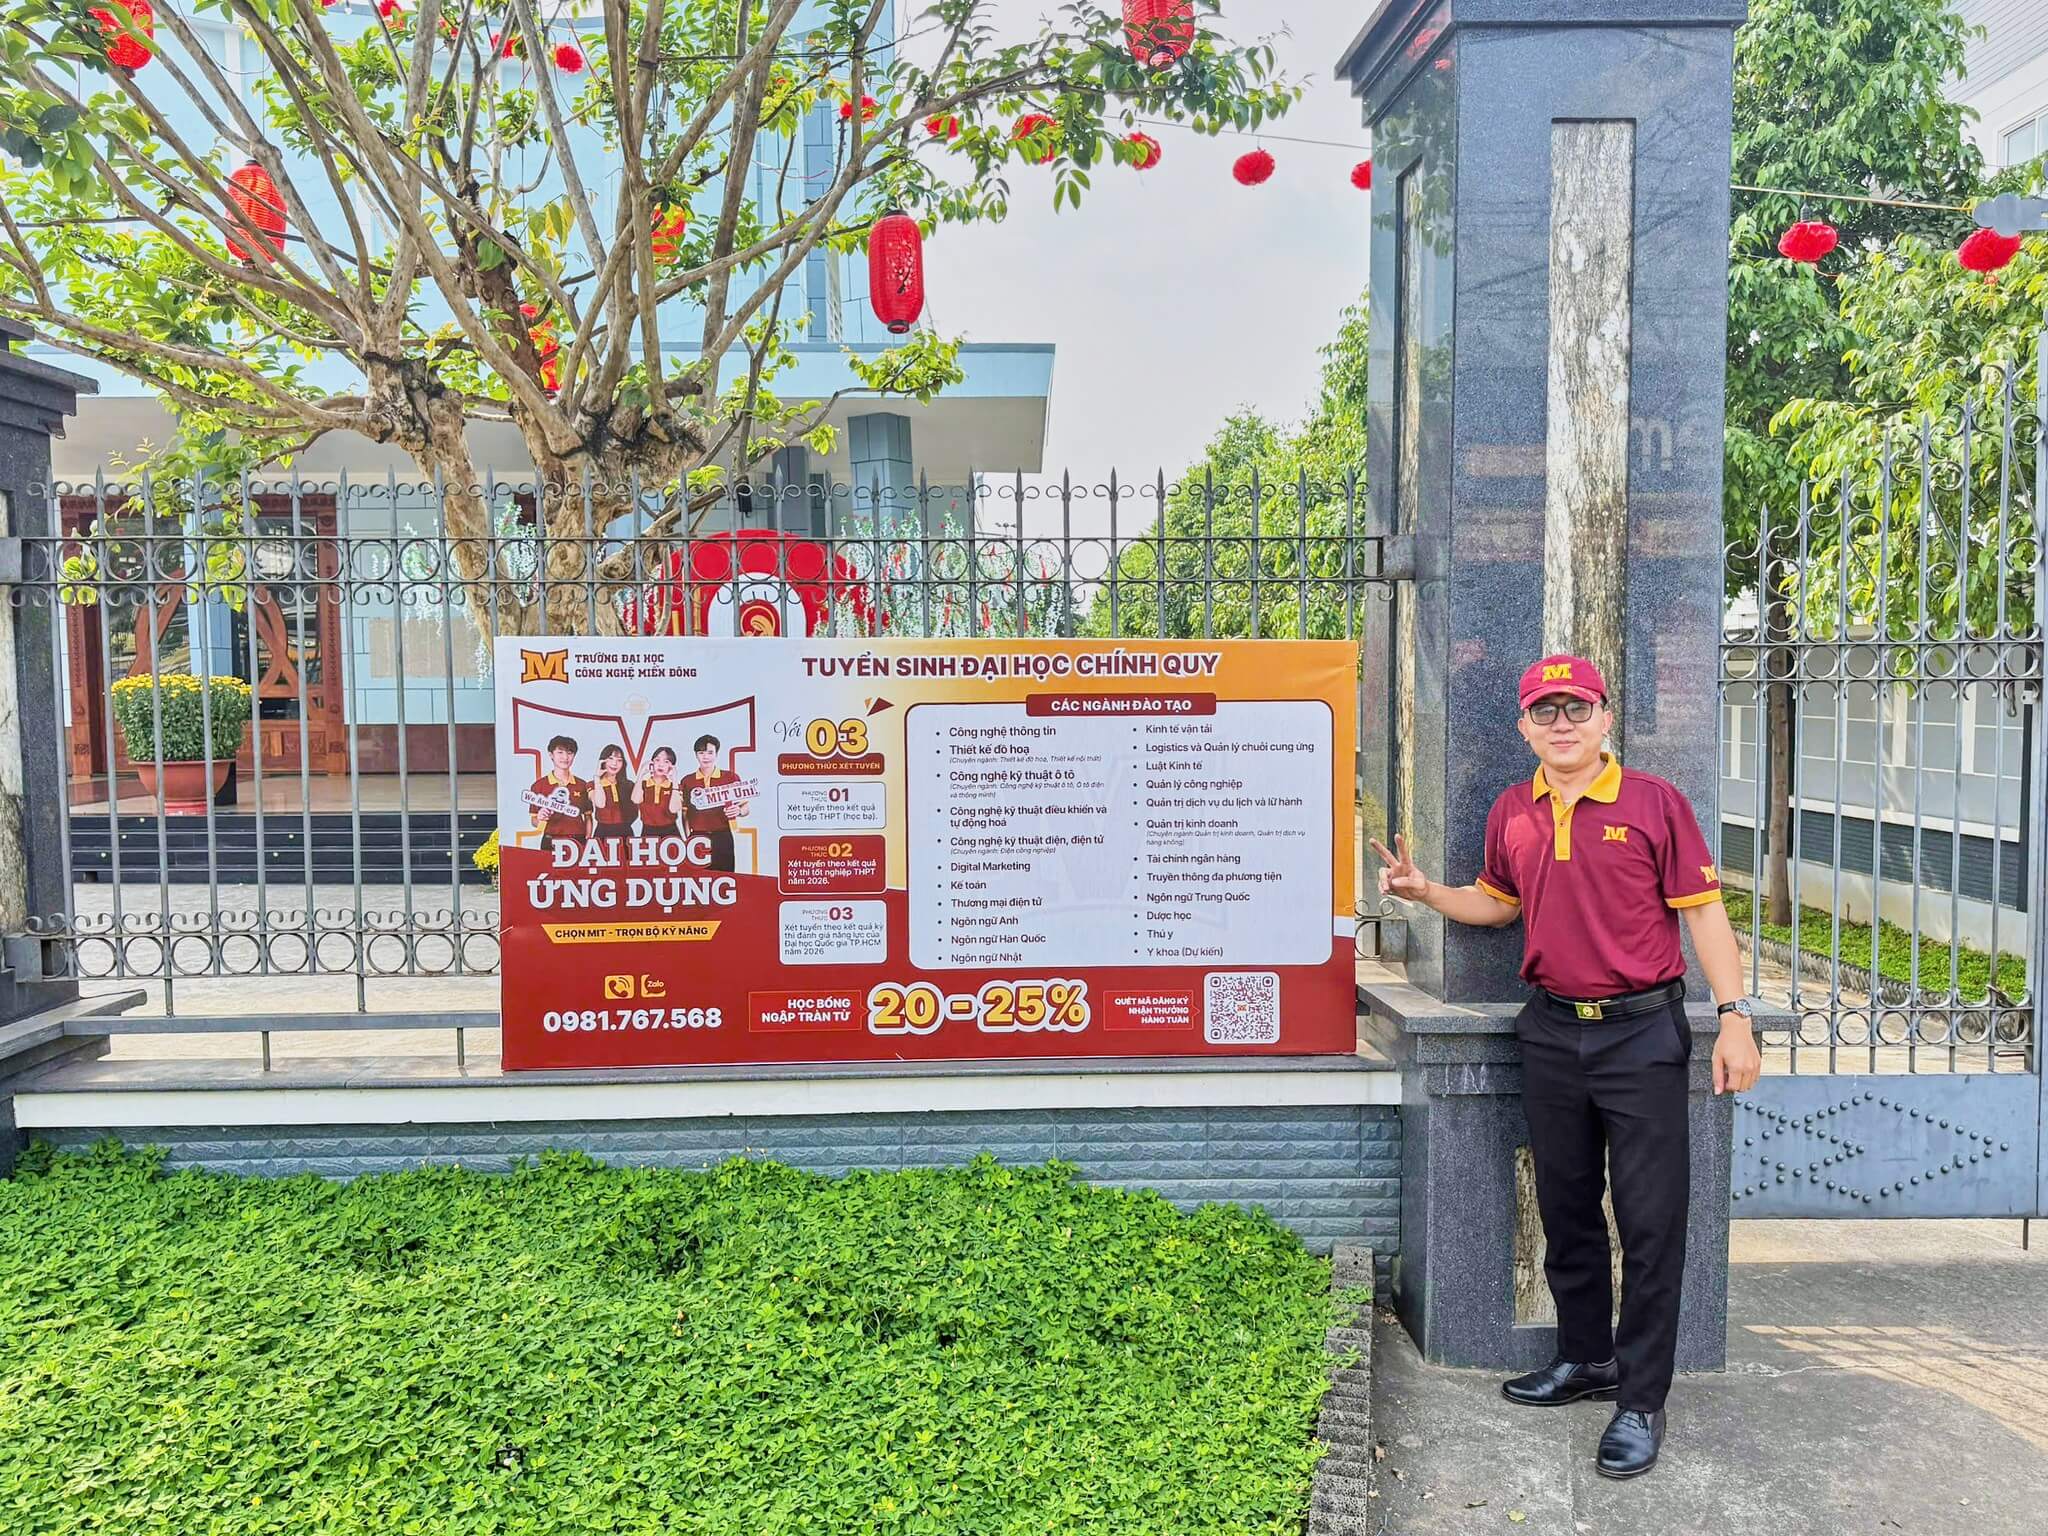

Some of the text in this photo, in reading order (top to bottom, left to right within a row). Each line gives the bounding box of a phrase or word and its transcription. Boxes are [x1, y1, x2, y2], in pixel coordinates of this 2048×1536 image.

[575, 652, 664, 665] TRƯỜNG ĐẠI HỌC
[520, 649, 569, 684] M
[802, 649, 1220, 681] TUYỂN SINH ĐẠI HỌC CHÍNH QUY
[575, 665, 696, 679] CÔNG NGHỆ MIỀN ĐÔNG
[1541, 663, 1572, 682] M
[1051, 698, 1192, 713] CÁC NGÀNH ĐÀO TẠO
[950, 726, 1056, 739] Công nghệ thông tin
[1146, 724, 1212, 735] Kinh tế vận tải
[774, 716, 868, 756] Với 03
[950, 744, 1030, 755] Thiết kế đồ hoạ
[1146, 742, 1314, 754] Logistics và Quản lý chuỗi cung ứng
[782, 762, 815, 770] PHƯƠNG
[816, 761, 837, 769] THỨC
[856, 761, 880, 769] TUYỂN
[1146, 760, 1202, 772] Luật Kinh tế
[950, 770, 1075, 782] Công nghệ kỹ thuật ô tô
[1146, 779, 1242, 790] Quản lý công nghiệp
[706, 790, 729, 803] MIT
[829, 788, 849, 802] 01
[803, 803, 824, 813] tuyển
[861, 803, 875, 812] quả
[950, 804, 1107, 817] Công nghệ kỹ thuật điều khiển và
[950, 818, 1006, 828] tự động hoá
[1147, 819, 1238, 829] Quản trị kinh doanh
[1602, 825, 1628, 842] M
[951, 834, 1104, 848] Công nghệ kỹ thuật điện, điện tử
[552, 836, 711, 874] ĐẠI HỌC
[828, 843, 852, 857] 02
[804, 859, 825, 868] tuyển
[862, 859, 876, 867] quả
[951, 861, 1030, 873] Digital Marketing
[788, 868, 797, 876] kỳ
[951, 880, 986, 890] Kế toán
[527, 873, 736, 913] ỨNG DỤNG
[952, 897, 1042, 909] Thương mại điện tử
[829, 907, 853, 920] 03
[1147, 911, 1191, 921] Dược học
[555, 929, 586, 938] CHỌN
[588, 929, 607, 937] MIT
[615, 928, 644, 938] TRỌN
[646, 926, 660, 937] BỘ
[662, 926, 676, 935] KỸ
[678, 925, 708, 935] NĂNG
[1147, 928, 1173, 940] Thú y
[1147, 947, 1223, 957] Y khoa (Dự kiến)
[647, 980, 664, 988] Zalo
[787, 998, 815, 1011] HỌC
[1115, 997, 1137, 1005] QUÉT
[1153, 997, 1176, 1005] ĐĂNG
[1177, 997, 1189, 1005] KÝ
[761, 1011, 796, 1025] NGẬP
[797, 1010, 830, 1022] TRÀN
[1129, 1007, 1153, 1016] NHẬN
[543, 1008, 722, 1032] 0981.767.568
[1142, 1016, 1189, 1024] HÀNG TUẦN
